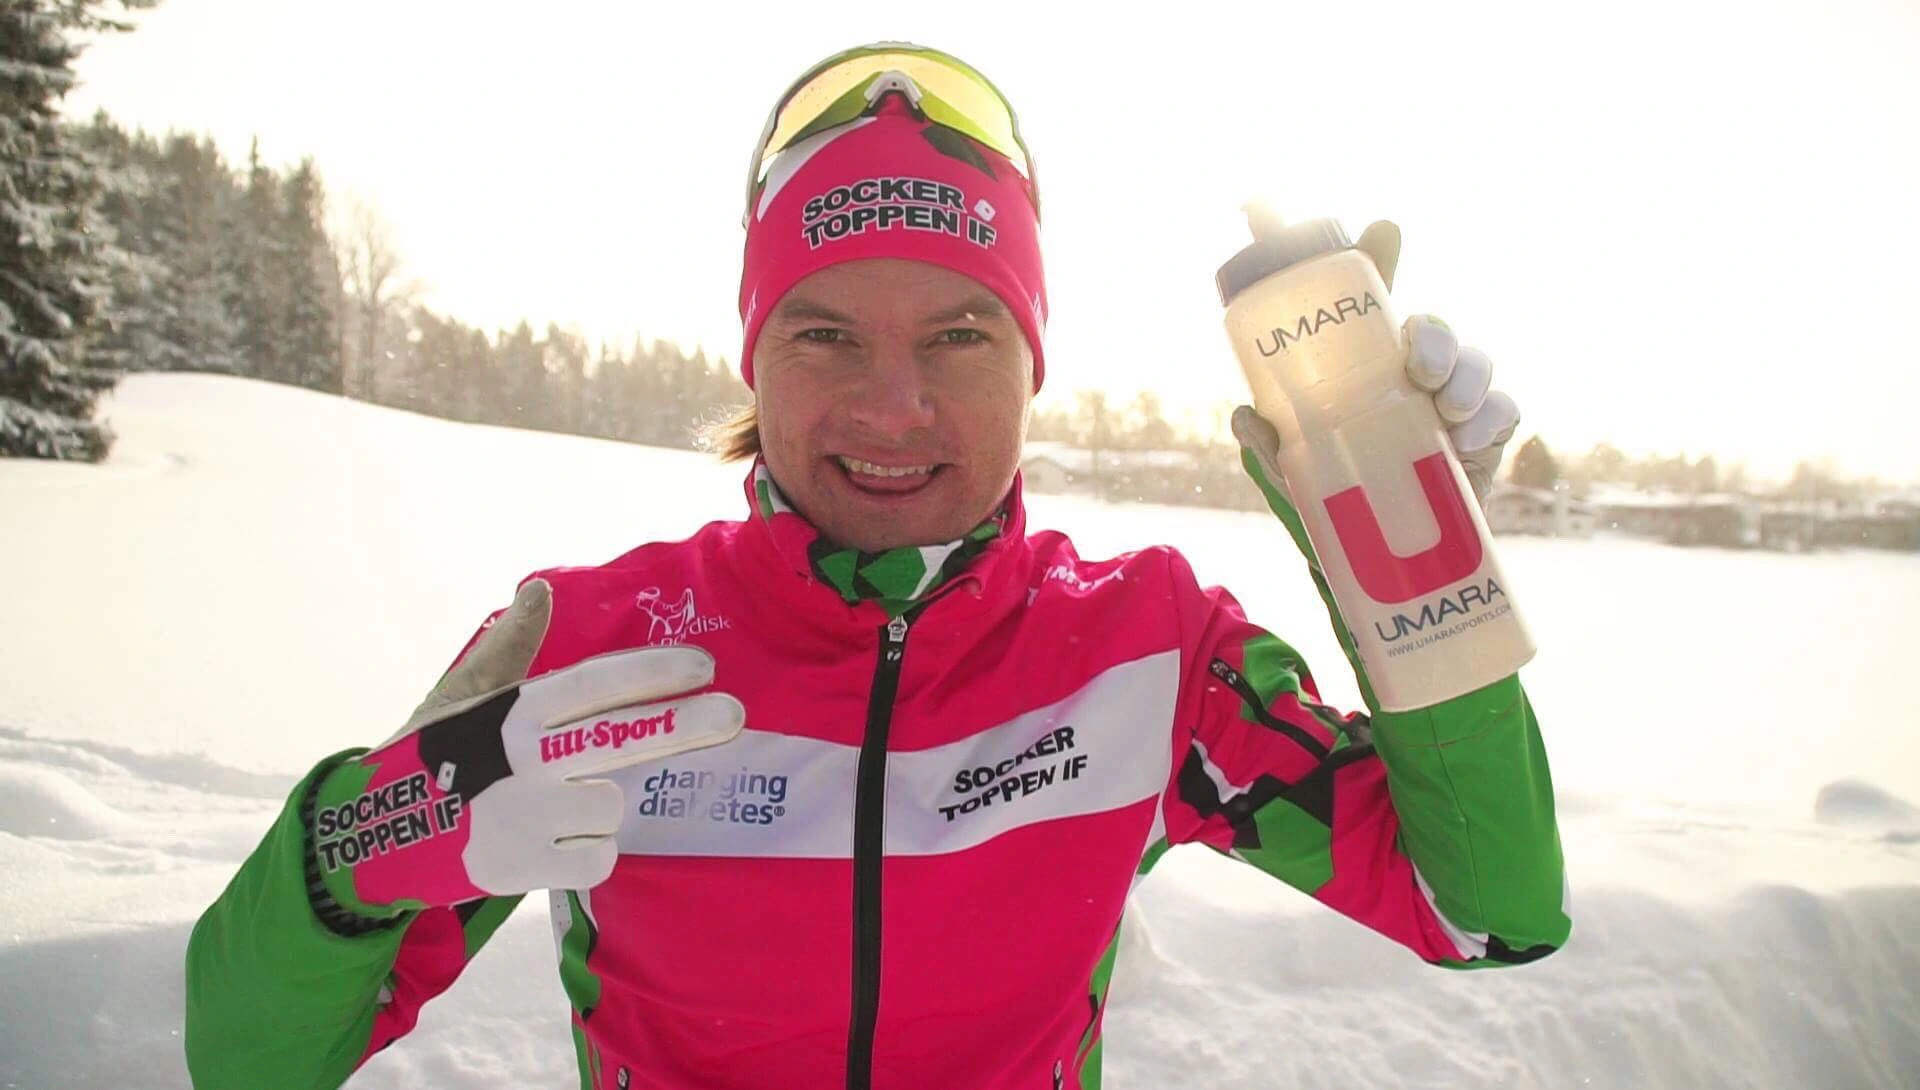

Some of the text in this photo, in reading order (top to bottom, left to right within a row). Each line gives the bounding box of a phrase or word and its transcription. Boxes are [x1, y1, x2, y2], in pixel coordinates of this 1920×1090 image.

[803, 177, 966, 222] SOCKER
[803, 203, 996, 250] TOPPEN IF
[1256, 291, 1382, 358] UMARA
[1322, 451, 1483, 604] U
[1374, 577, 1506, 643] UMARA
[644, 767, 789, 804] changing
[938, 754, 1089, 822] TOPPEN IF
[954, 726, 1075, 794] SOCKER
[317, 772, 431, 838] SOCKER
[318, 794, 462, 872] TOPPEN IF
